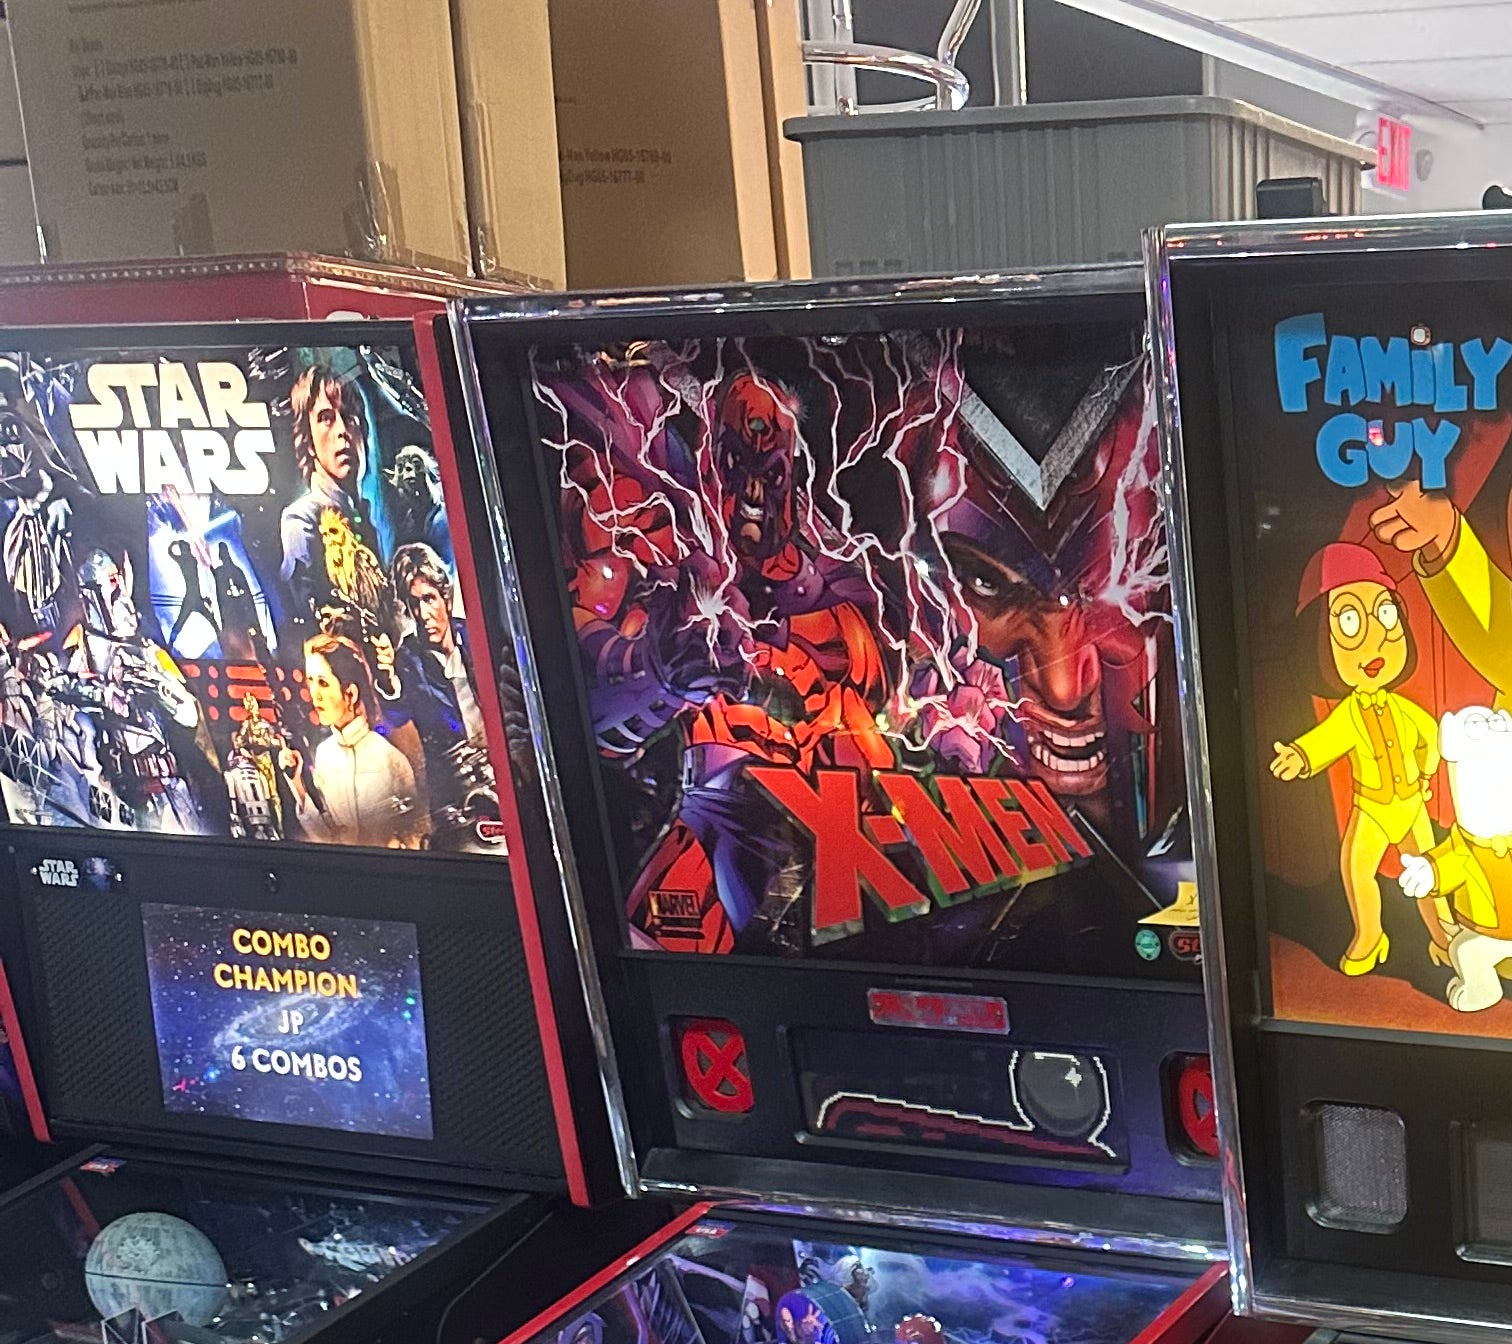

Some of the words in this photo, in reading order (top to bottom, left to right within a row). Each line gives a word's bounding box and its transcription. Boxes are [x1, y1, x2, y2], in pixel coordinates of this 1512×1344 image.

[70, 360, 271, 429] STAR
[73, 430, 276, 495] WARS
[1316, 414, 1461, 489] GUY
[39, 858, 76, 874] STAR
[745, 766, 1094, 937] X-MEN
[40, 871, 79, 887] WARS
[233, 929, 331, 960] COMBO
[214, 964, 358, 997] CHAMPION
[278, 1009, 304, 1035] JP
[232, 1047, 245, 1071] 6
[252, 1049, 362, 1082] COMBOS
